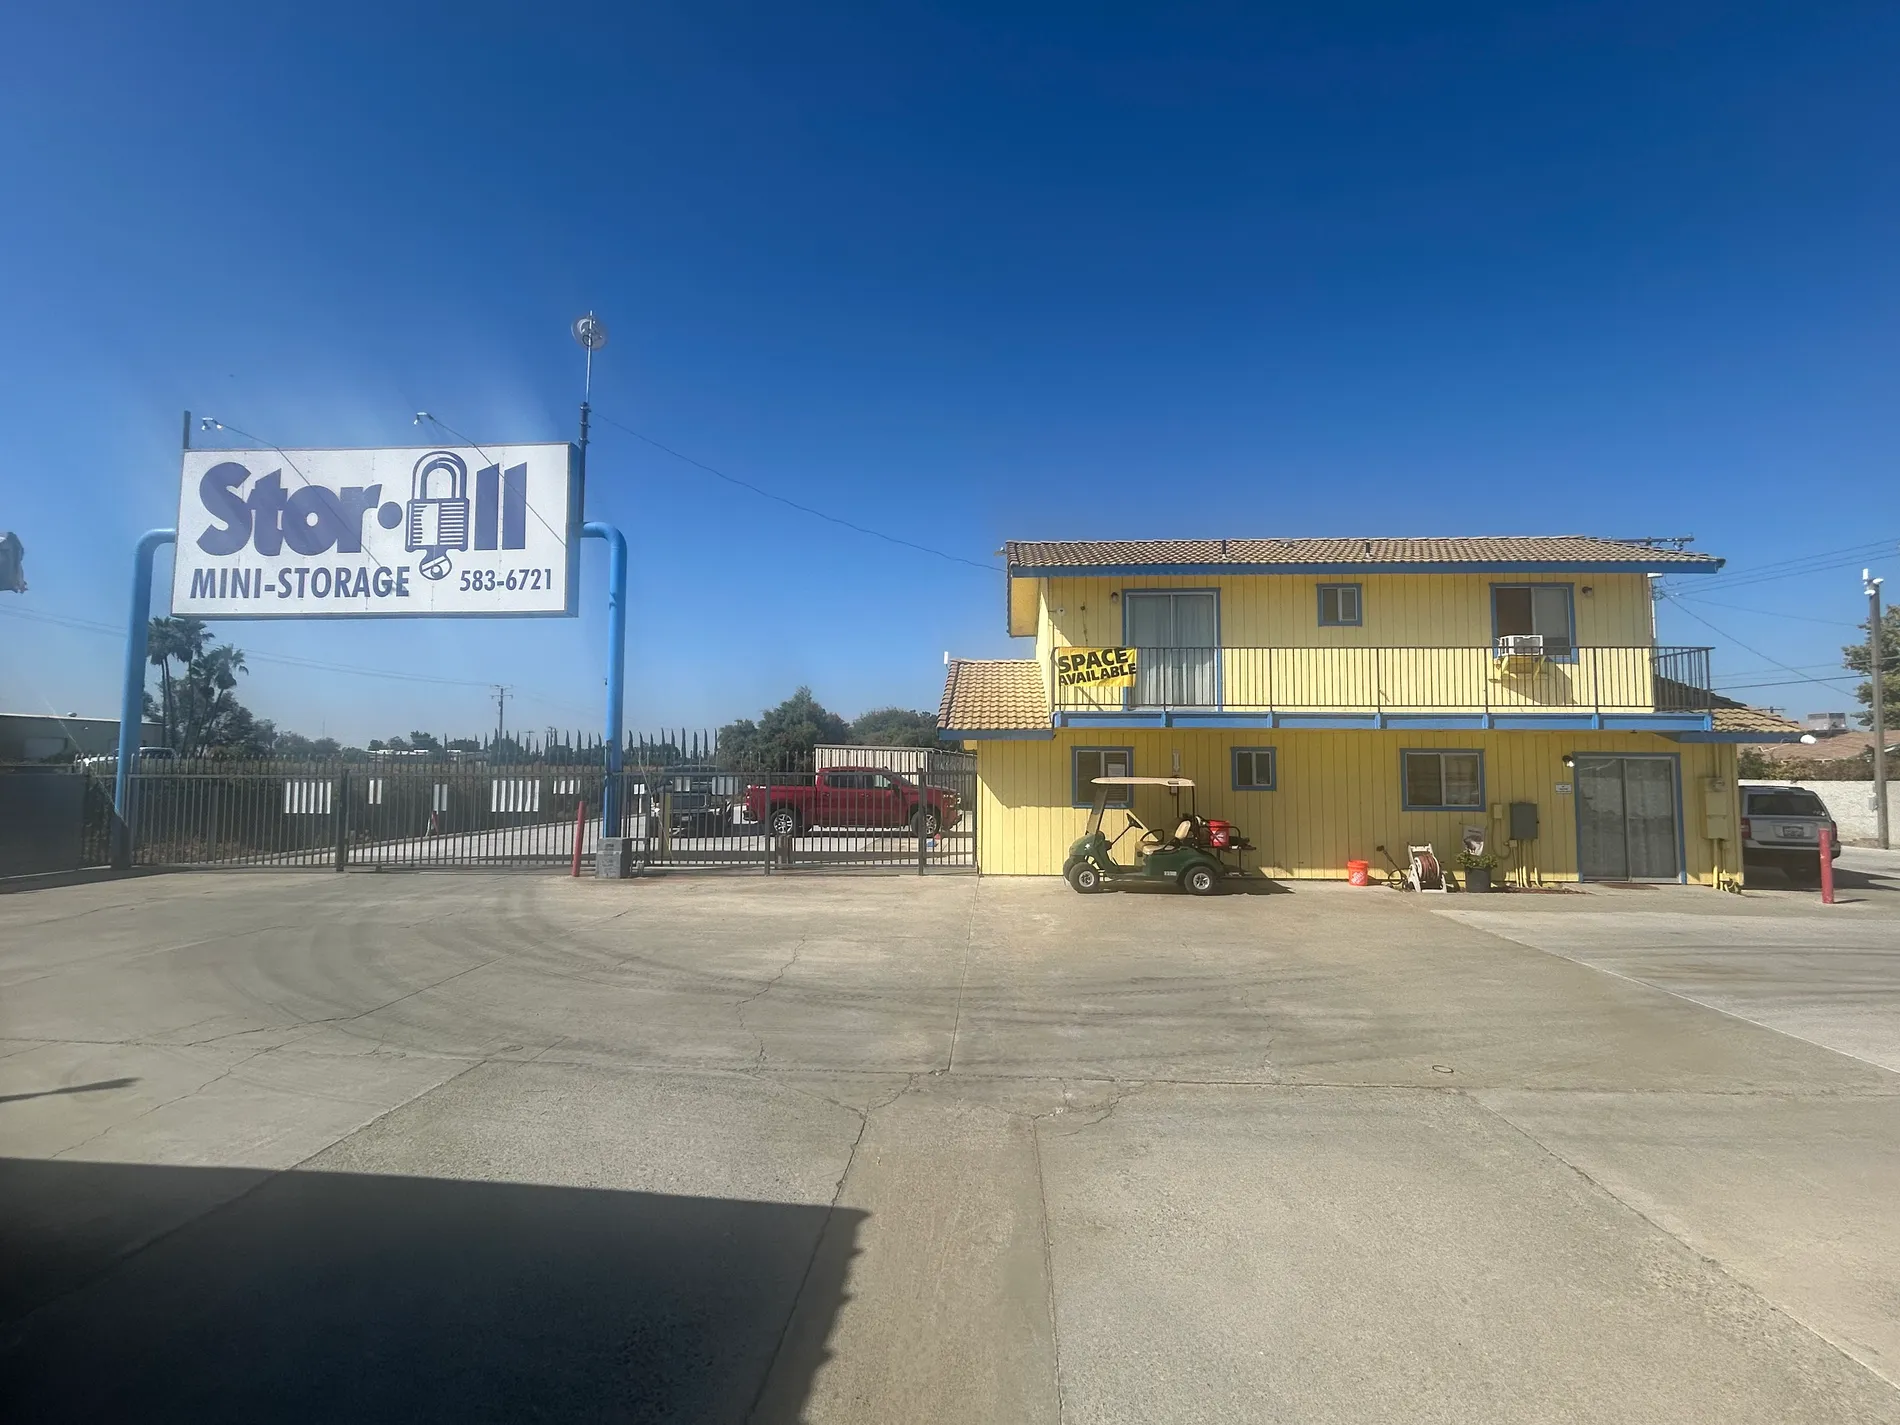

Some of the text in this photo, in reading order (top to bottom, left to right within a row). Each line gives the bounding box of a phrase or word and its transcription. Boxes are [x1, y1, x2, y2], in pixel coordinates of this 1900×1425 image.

[190, 566, 410, 598] MINI-STORAGE
[459, 568, 552, 592] 583-6721
[1058, 647, 1128, 673] SPACE
[1059, 663, 1137, 686] AVAILABLE
